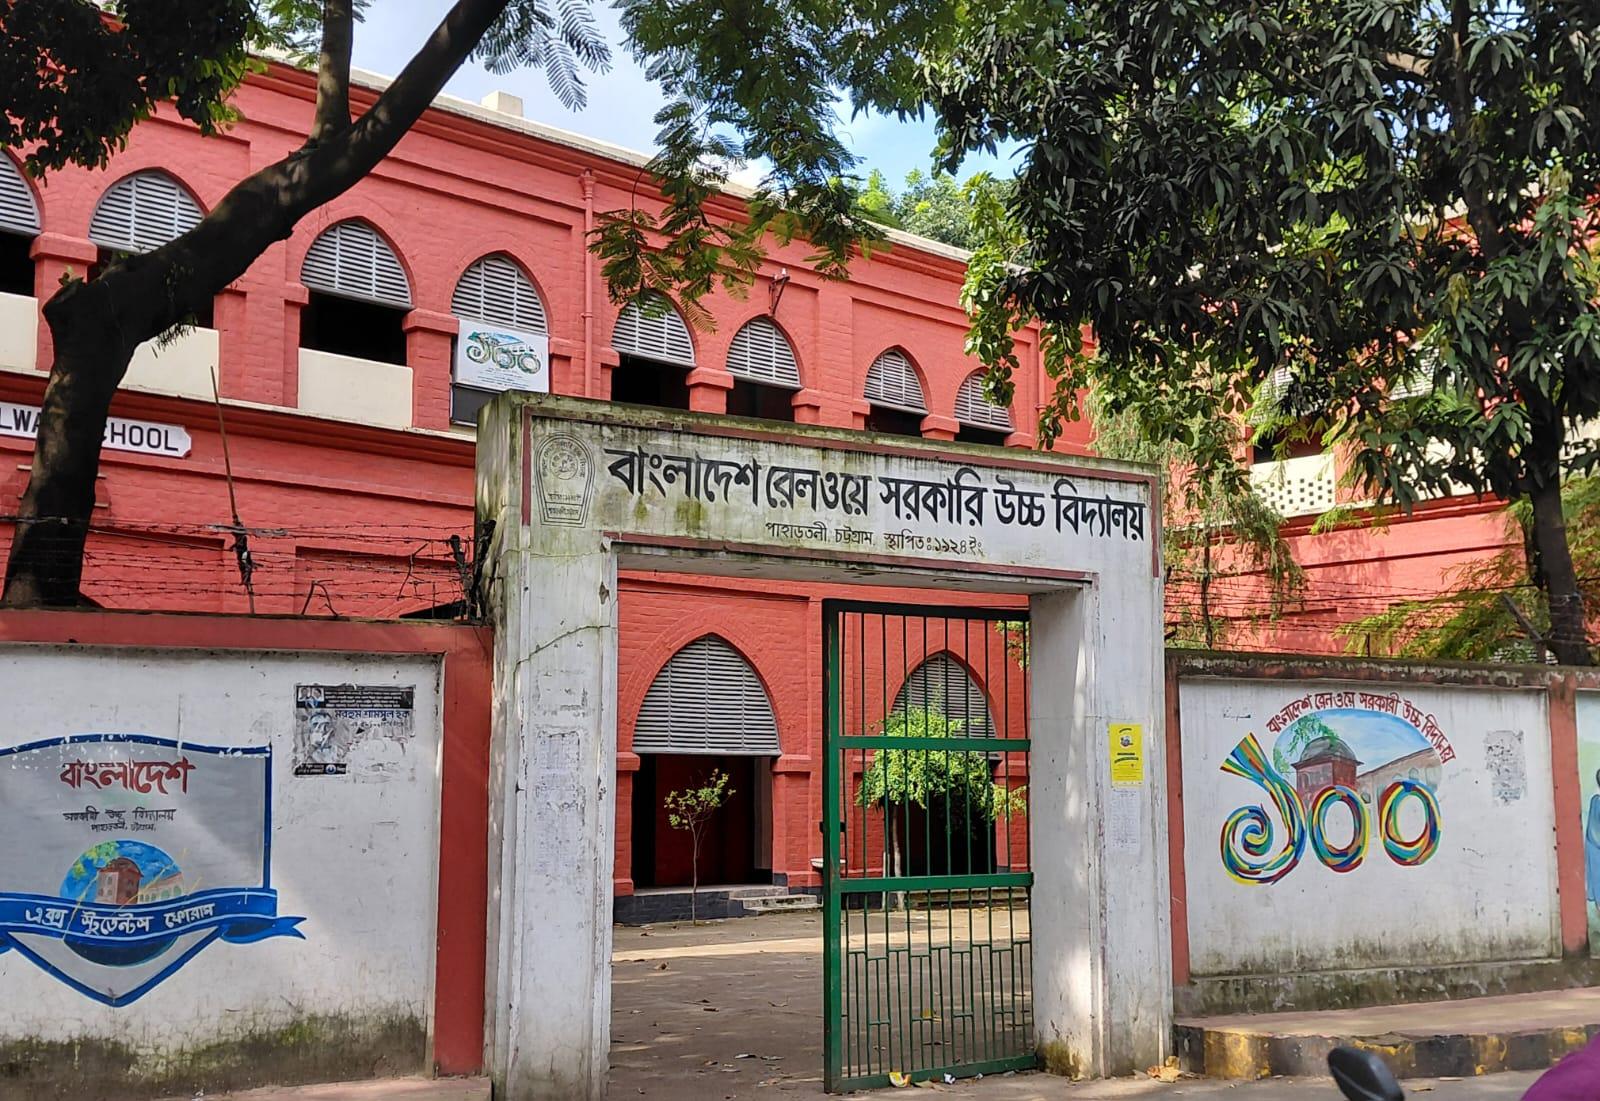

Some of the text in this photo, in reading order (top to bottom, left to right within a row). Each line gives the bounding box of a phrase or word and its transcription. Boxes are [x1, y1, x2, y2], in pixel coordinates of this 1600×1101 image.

[101, 422, 179, 451] HOOL
[604, 445, 763, 506] বাংলাদেশ
[765, 465, 872, 516] রেলওয়ে
[878, 466, 989, 527] সরকারি
[993, 475, 1046, 527] উচ্চ
[1051, 478, 1146, 541] বিদ্যালয়
[1266, 693, 1312, 732] বাংলাদেশ
[1358, 691, 1401, 715] সরকারী
[1403, 698, 1424, 728] উচ্চ
[1421, 713, 1457, 764] বিদ্যালয়
[59, 756, 196, 795] বাংলাদেশ
[1219, 731, 1443, 886] ১০০
[163, 902, 216, 929] ফোরাম
